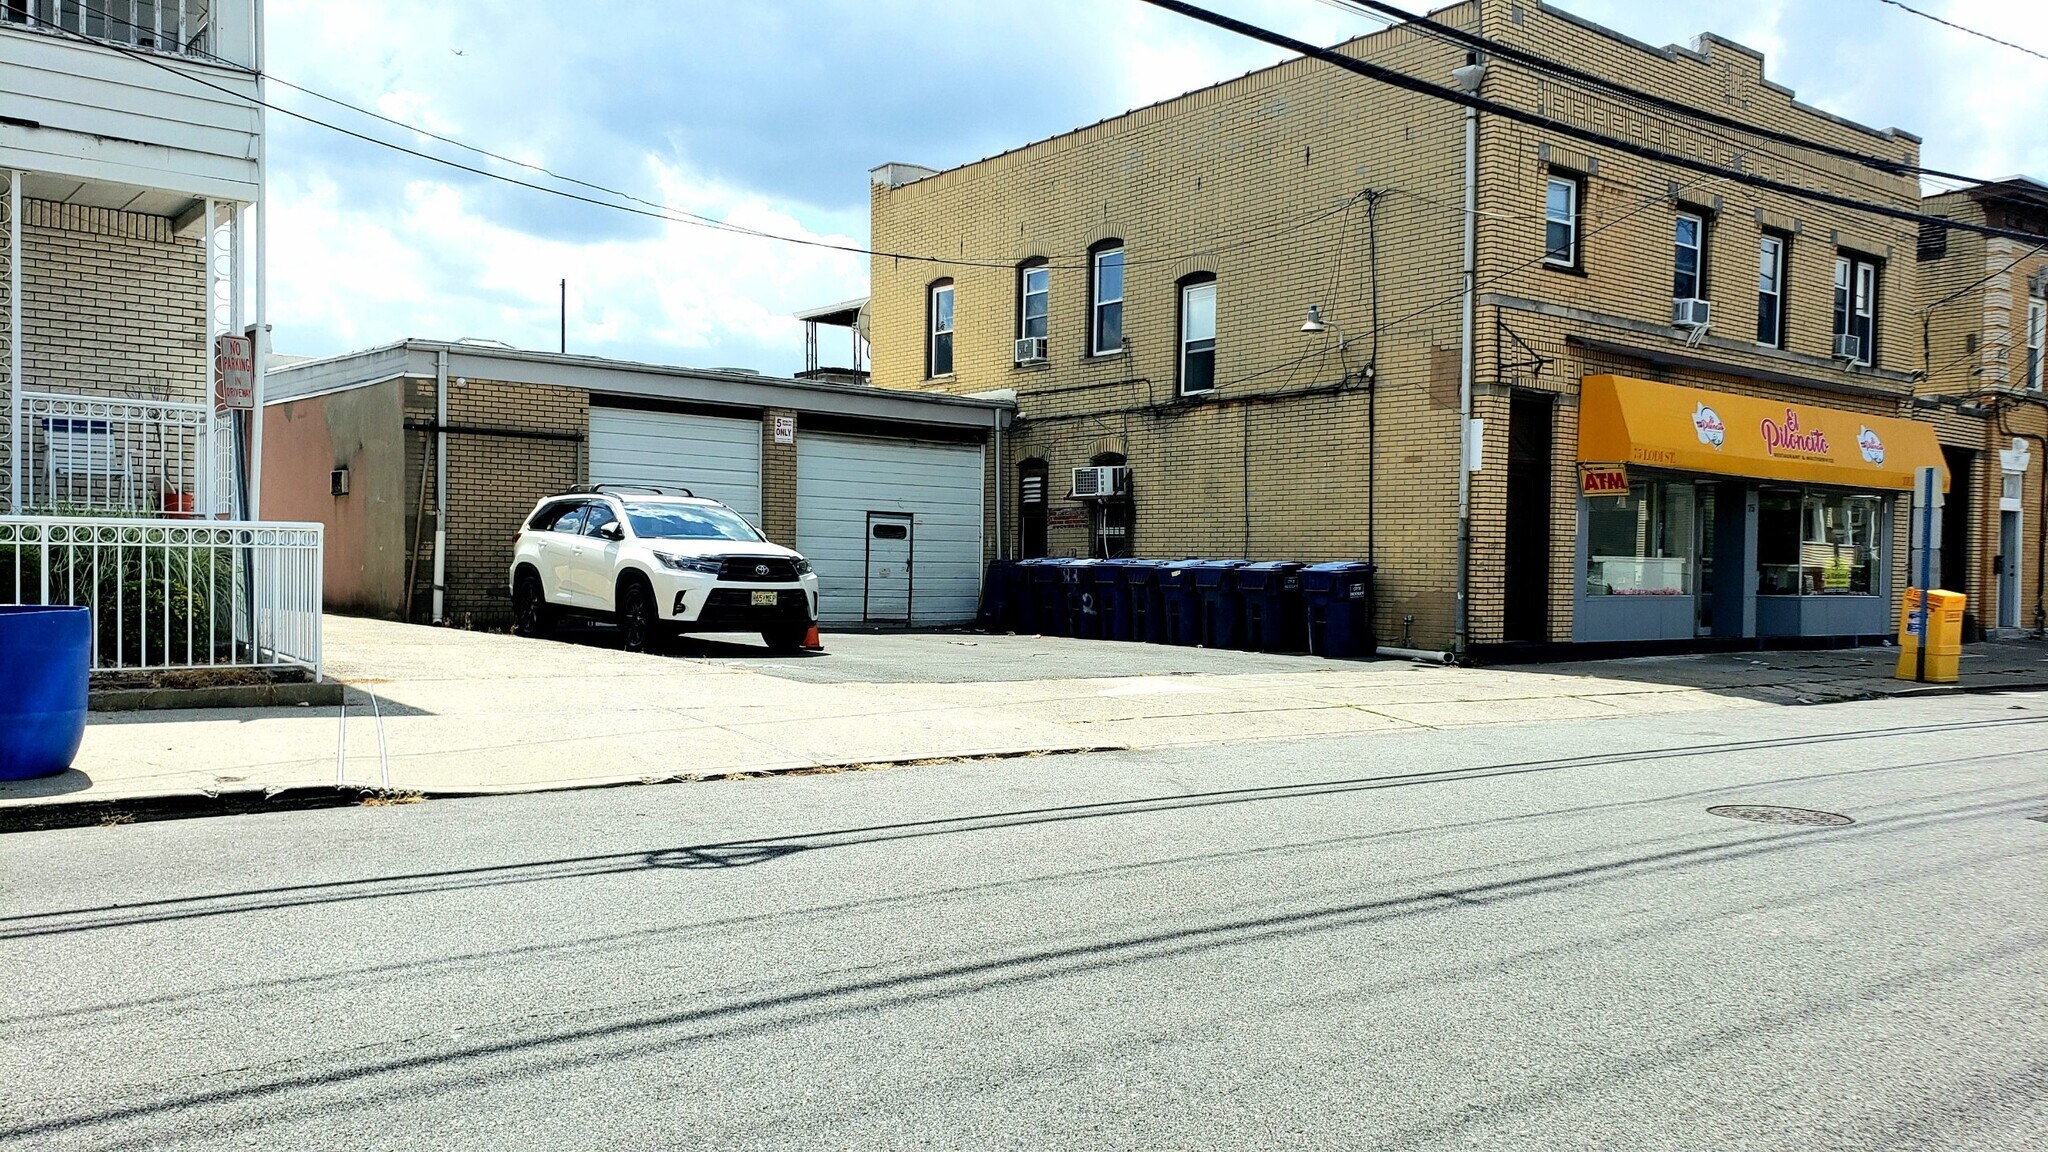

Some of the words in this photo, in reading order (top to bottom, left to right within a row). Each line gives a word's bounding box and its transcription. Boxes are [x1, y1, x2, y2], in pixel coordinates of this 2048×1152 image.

[230, 341, 241, 356] NO
[223, 357, 250, 372] PARKING
[234, 376, 242, 386] IN
[226, 387, 252, 398] DRIVEWAY
[776, 418, 782, 428] 5
[1786, 408, 1799, 432] El
[776, 428, 792, 437] ONLY
[1761, 418, 1829, 455] Piloncito
[1584, 472, 1628, 491] ATM
